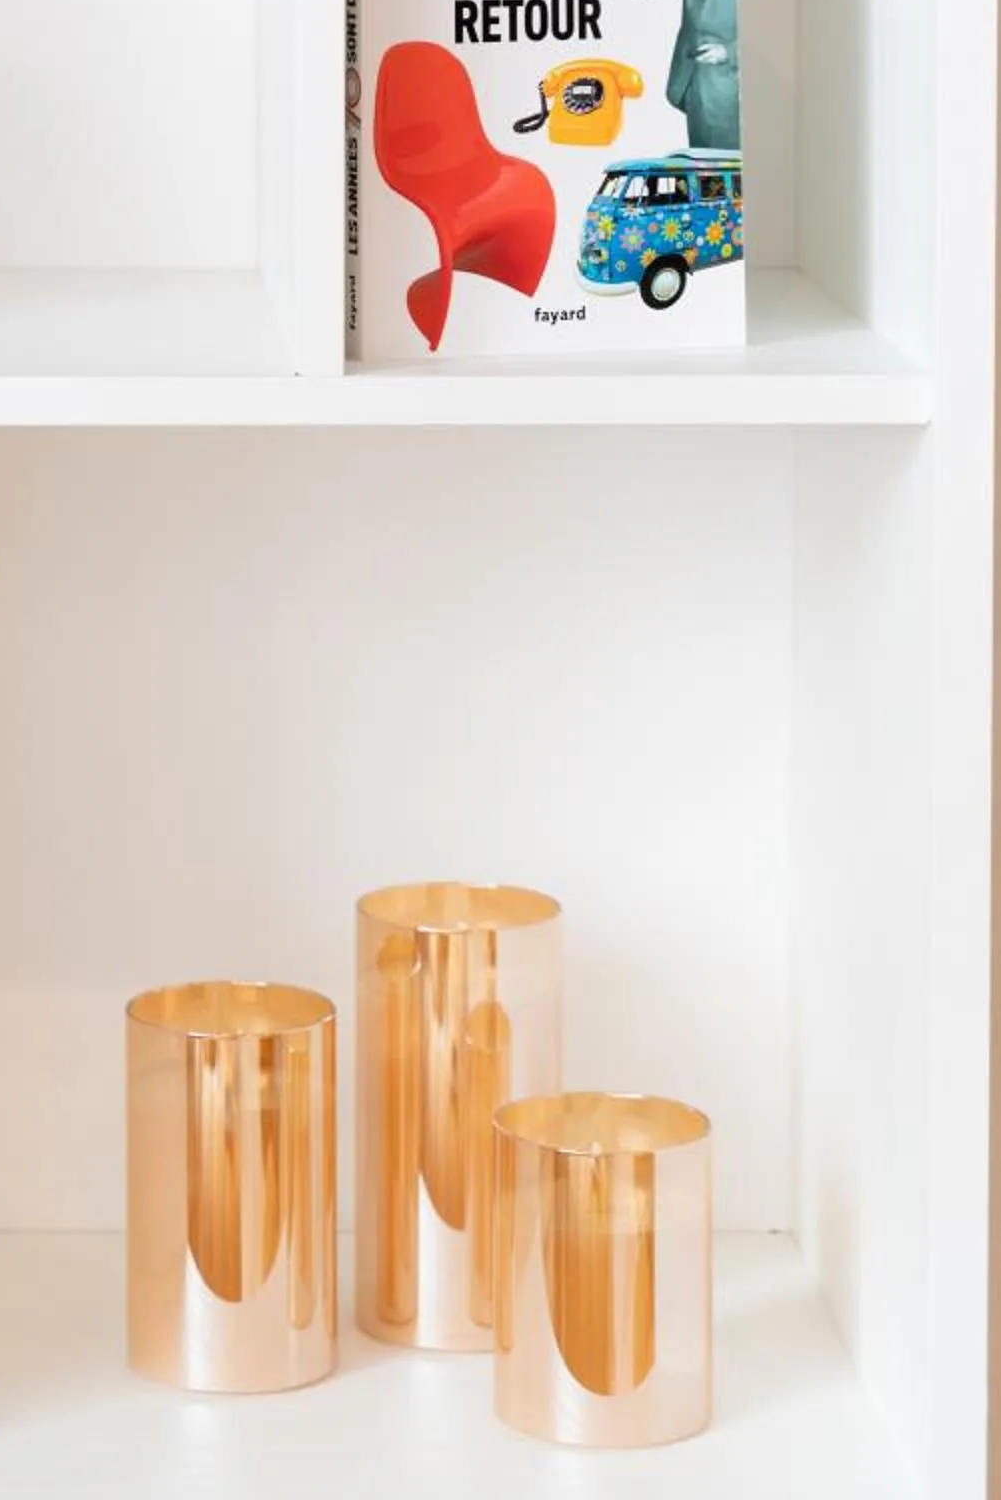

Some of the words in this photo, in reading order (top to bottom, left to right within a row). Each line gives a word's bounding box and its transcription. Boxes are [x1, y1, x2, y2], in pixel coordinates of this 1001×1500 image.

[345, 10, 357, 64] SONT
[345, 67, 362, 130] 70
[347, 219, 358, 257] LES
[348, 274, 357, 332] fayard
[534, 305, 587, 324] fayard
